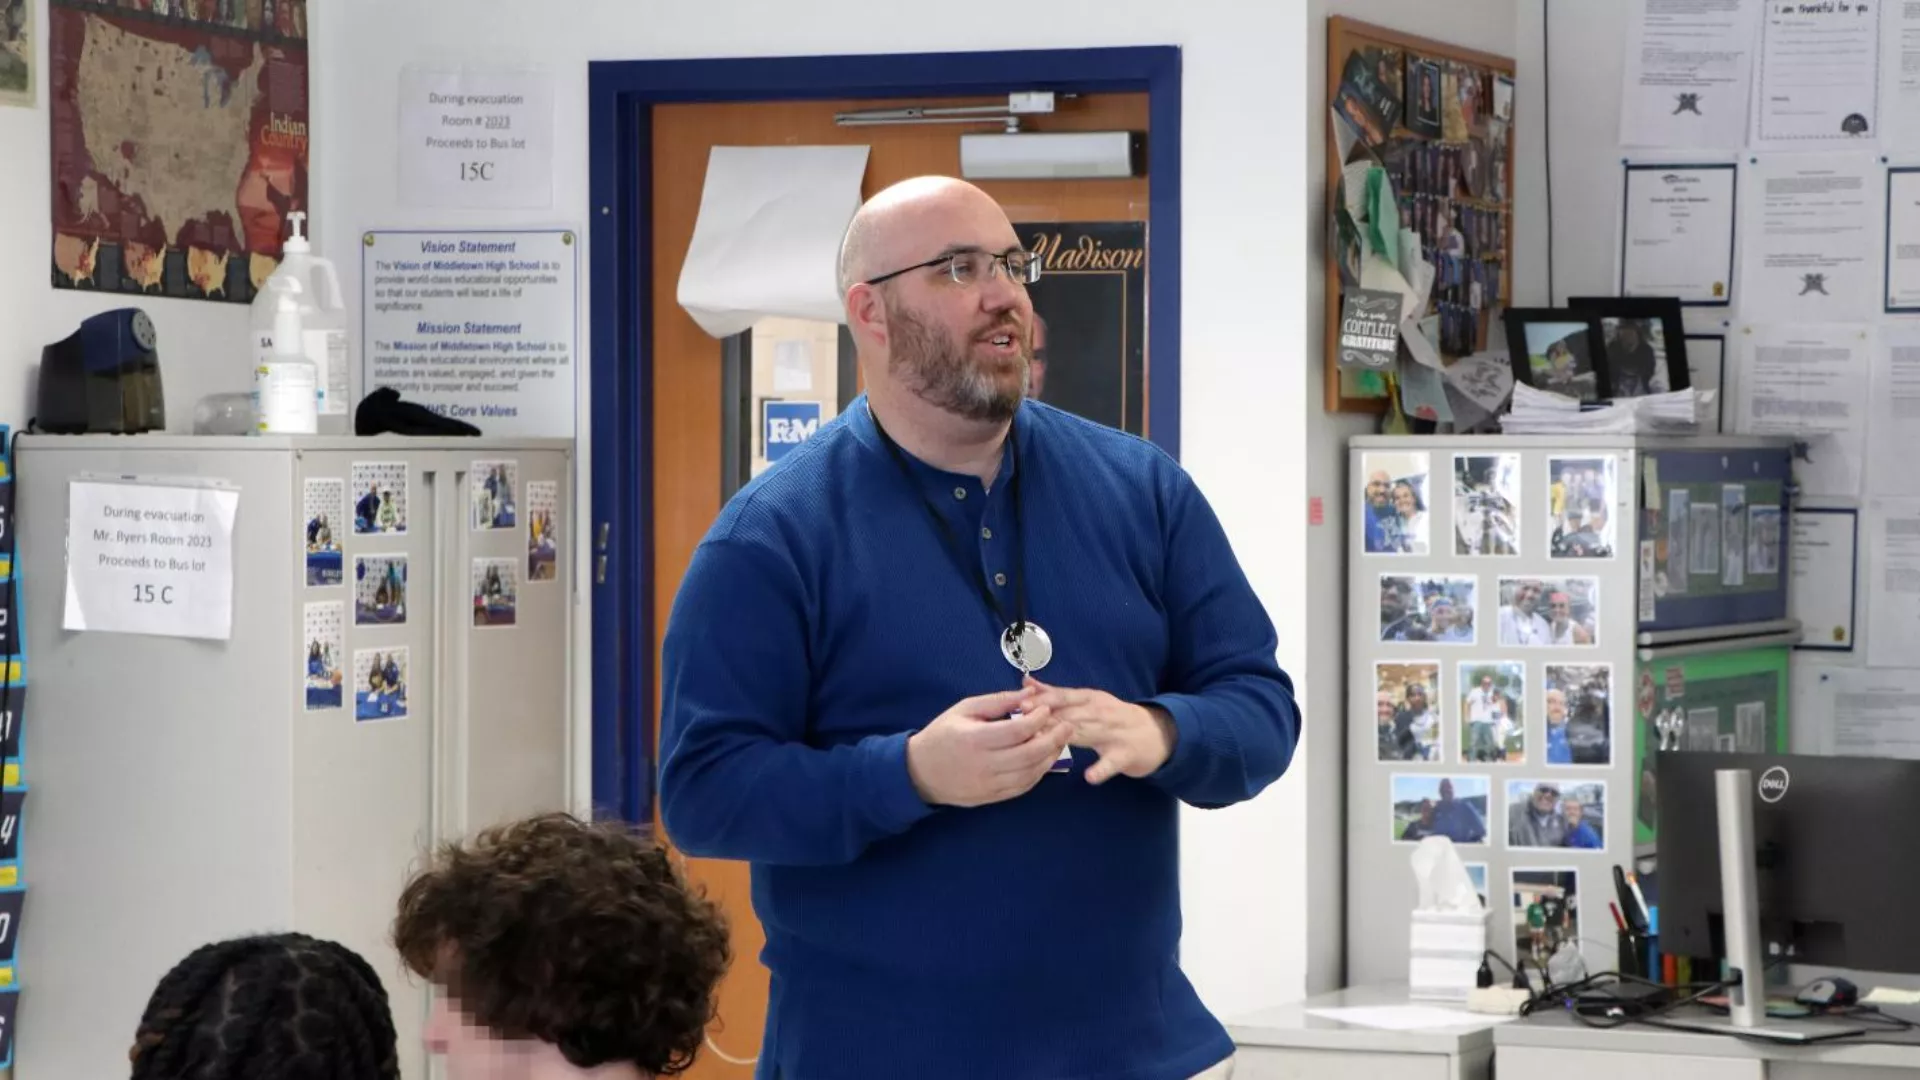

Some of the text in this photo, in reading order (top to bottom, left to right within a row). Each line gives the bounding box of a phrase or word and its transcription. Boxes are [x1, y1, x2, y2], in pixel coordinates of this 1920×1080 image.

[429, 92, 523, 106] During evacuation
[270, 111, 305, 136] Indian
[441, 115, 473, 126] Room
[475, 116, 482, 126] #
[260, 124, 307, 158] Country
[426, 136, 525, 149] Proceeds to Bus lot
[460, 162, 494, 181] 15C
[421, 240, 516, 253] Vision Statement
[1032, 232, 1143, 269] Madison
[375, 260, 560, 273] The Vision of Middletown High School is to
[407, 274, 452, 284] world-class
[454, 274, 500, 284] educational
[503, 274, 557, 286] opportunities
[375, 289, 385, 298] so
[387, 288, 403, 298] that
[405, 289, 418, 298] our
[420, 288, 454, 298] students
[457, 288, 470, 298] will
[513, 288, 522, 298] of
[417, 321, 522, 334] Mission Statement
[1344, 318, 1396, 338] COMPLETE
[375, 341, 567, 353] The Mission of Middletown High School is to
[1342, 334, 1396, 352] GRATITUDE
[374, 356, 400, 365] create
[411, 355, 428, 365] safe
[430, 355, 476, 365] educational
[479, 355, 530, 365] environment
[532, 355, 557, 365] where
[559, 355, 569, 365] all
[374, 368, 409, 378] students
[412, 370, 425, 378] are
[500, 369, 516, 378] and
[518, 369, 539, 381] given
[541, 369, 555, 378] the
[422, 382, 431, 391] to
[433, 383, 464, 393] prosper
[466, 382, 482, 391] and
[450, 404, 477, 417] Core
[480, 404, 517, 417] Values
[103, 505, 204, 523] During evacuation
[93, 529, 212, 548] Mr. Byers Room 2023
[99, 554, 206, 571] Proceeds to Bus lot
[133, 584, 174, 604] 15 C
[1763, 779, 1785, 789] DELL
